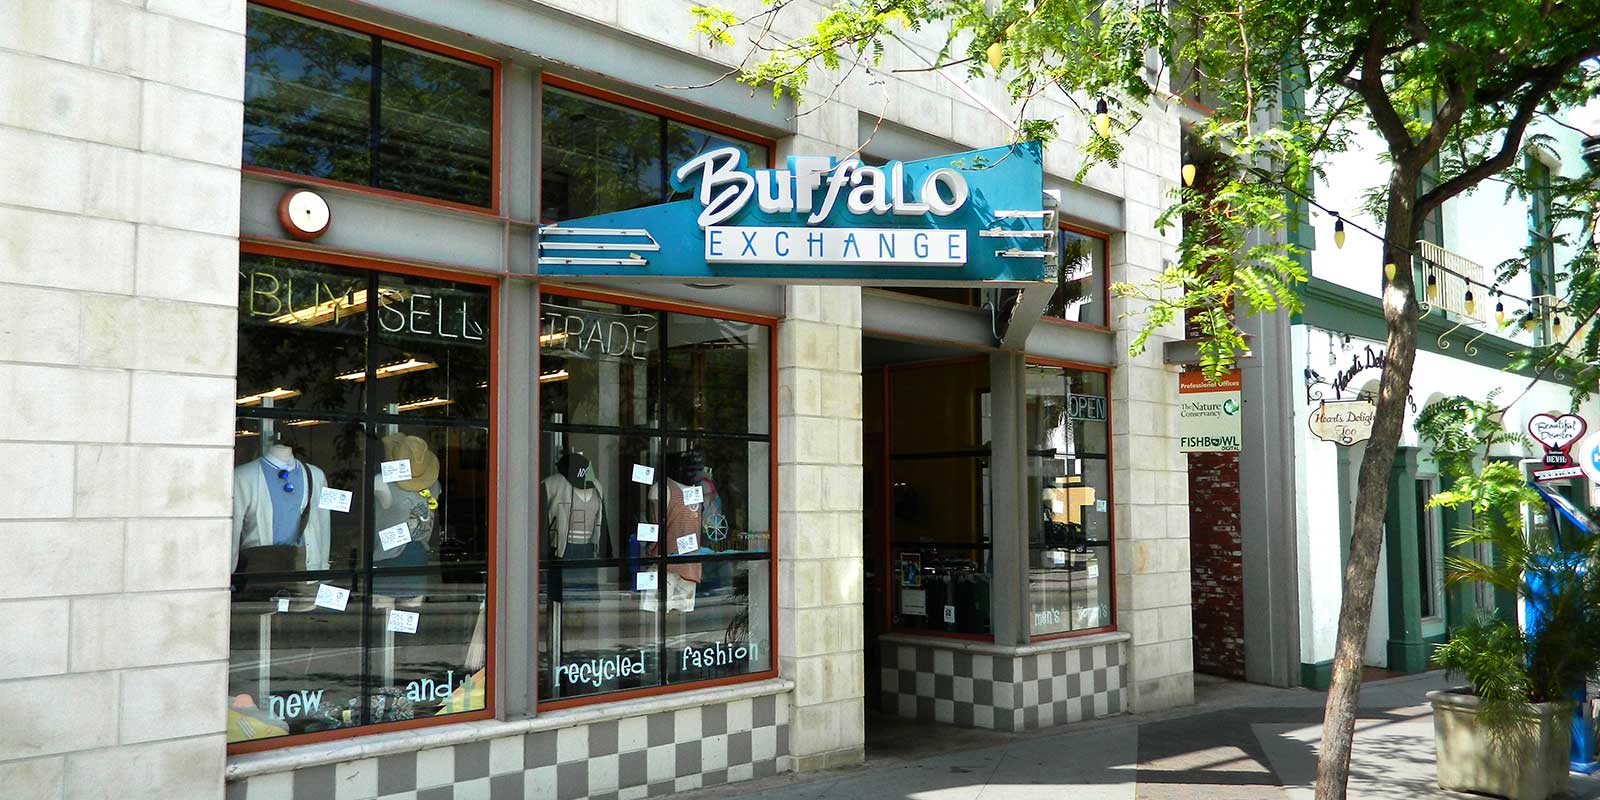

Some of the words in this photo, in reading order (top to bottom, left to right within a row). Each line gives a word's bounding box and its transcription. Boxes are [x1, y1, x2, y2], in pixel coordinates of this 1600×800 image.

[709, 230, 962, 259] EXCHANGE
[250, 272, 353, 325] BUY
[379, 289, 482, 340] SELL
[545, 312, 648, 360] TRADE
[1331, 354, 1364, 400] Hearts
[1069, 396, 1105, 419] OPEN
[1180, 410, 1221, 419] Conservancy
[1192, 402, 1222, 411] Nature
[1314, 412, 1344, 424] Hearts
[1347, 411, 1376, 426] Deligh
[1034, 608, 1060, 626] men's
[554, 650, 646, 687] recycled
[681, 641, 760, 671] fashion
[269, 689, 323, 720] new
[406, 670, 454, 702] and
